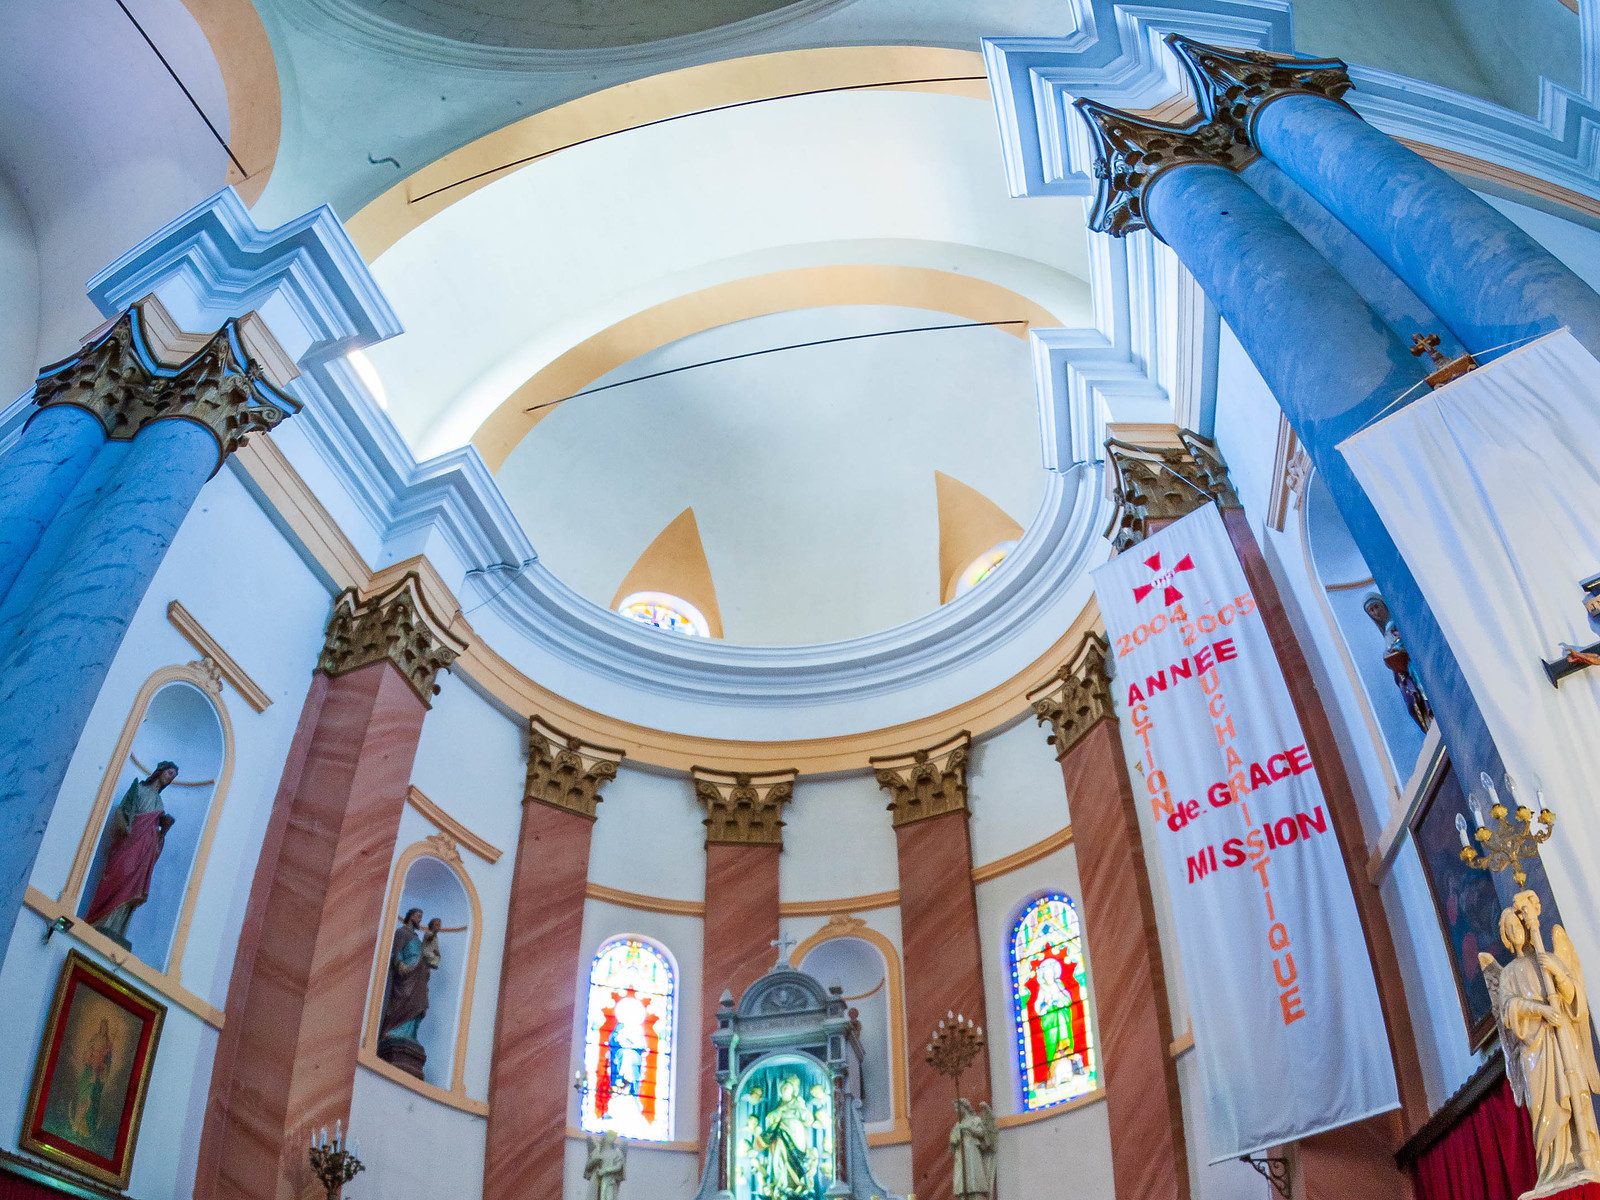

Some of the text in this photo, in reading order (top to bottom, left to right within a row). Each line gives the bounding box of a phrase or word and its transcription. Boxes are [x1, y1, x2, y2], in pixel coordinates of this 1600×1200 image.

[1115, 592, 1256, 659] 2004 2005
[1128, 637, 1238, 707] ANNEE
[1207, 744, 1314, 809] GRACE
[1186, 805, 1327, 885] MISSION
